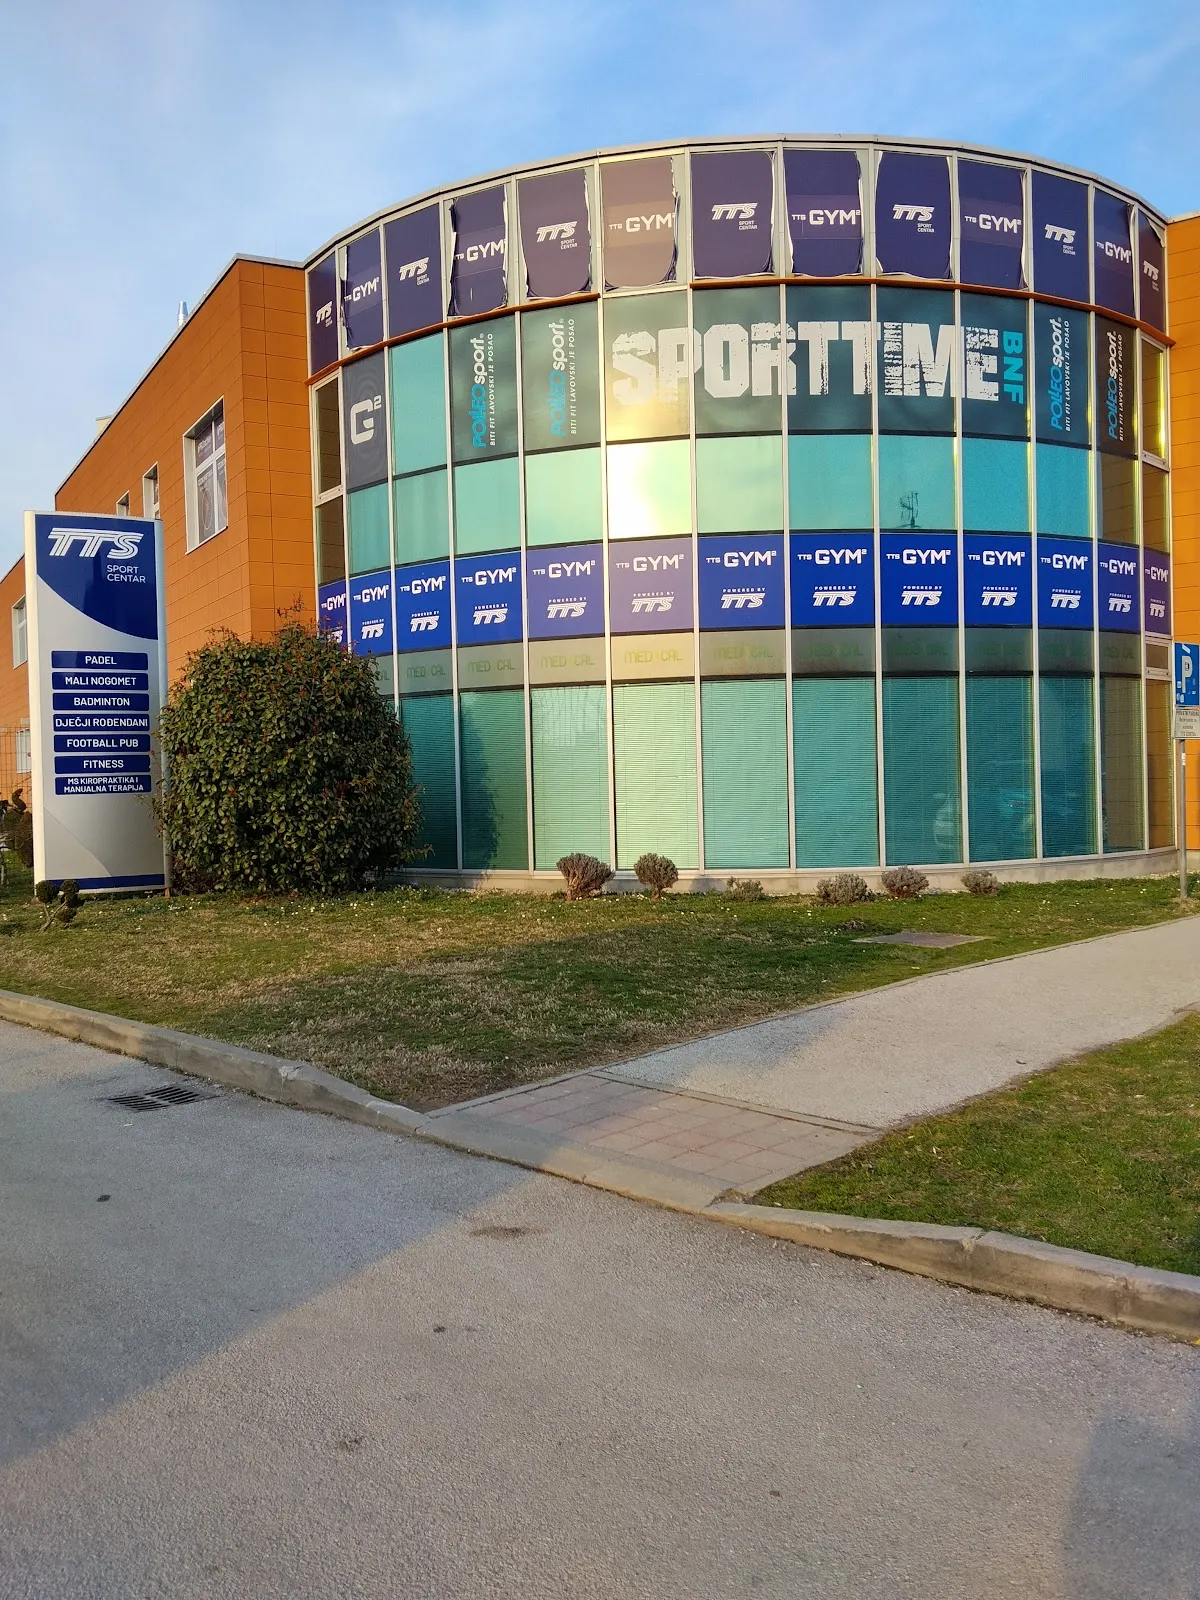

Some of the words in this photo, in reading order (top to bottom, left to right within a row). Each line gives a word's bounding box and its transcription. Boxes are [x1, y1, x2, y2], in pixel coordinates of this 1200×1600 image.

[712, 203, 758, 220] TTS
[893, 204, 934, 221] TTS
[536, 221, 577, 242] TTS
[1045, 224, 1076, 243] TTS
[399, 257, 429, 281] TTS
[1143, 260, 1159, 280] TTS
[316, 301, 332, 324] TTS
[569, 351, 574, 359] JE
[1064, 352, 1070, 360] JE
[1003, 330, 1023, 404] BNF
[48, 528, 144, 559] TTS
[107, 565, 139, 573] SPORT
[107, 574, 146, 583] CENTAR
[632, 597, 674, 613] TTS
[721, 593, 765, 608] TTS
[813, 591, 856, 606] TTS
[901, 591, 942, 605] TTS
[981, 592, 1018, 606] TTS
[1051, 594, 1081, 608] TTS
[1109, 598, 1131, 612] TTS
[473, 608, 508, 625] TTS
[547, 602, 587, 619] TTS
[361, 623, 384, 639] TTS
[410, 616, 439, 632] TTS
[85, 656, 117, 664] PADEL
[65, 677, 88, 685] MALI
[91, 677, 136, 686] NOGOMET
[1182, 656, 1193, 693] P
[74, 697, 130, 706] BADMINTON
[55, 717, 90, 727] DJEČJI
[93, 719, 148, 727] ROĐENDANI
[67, 739, 117, 748] FOOTBALL
[120, 739, 138, 747] PUB
[83, 760, 124, 769] FITNESS
